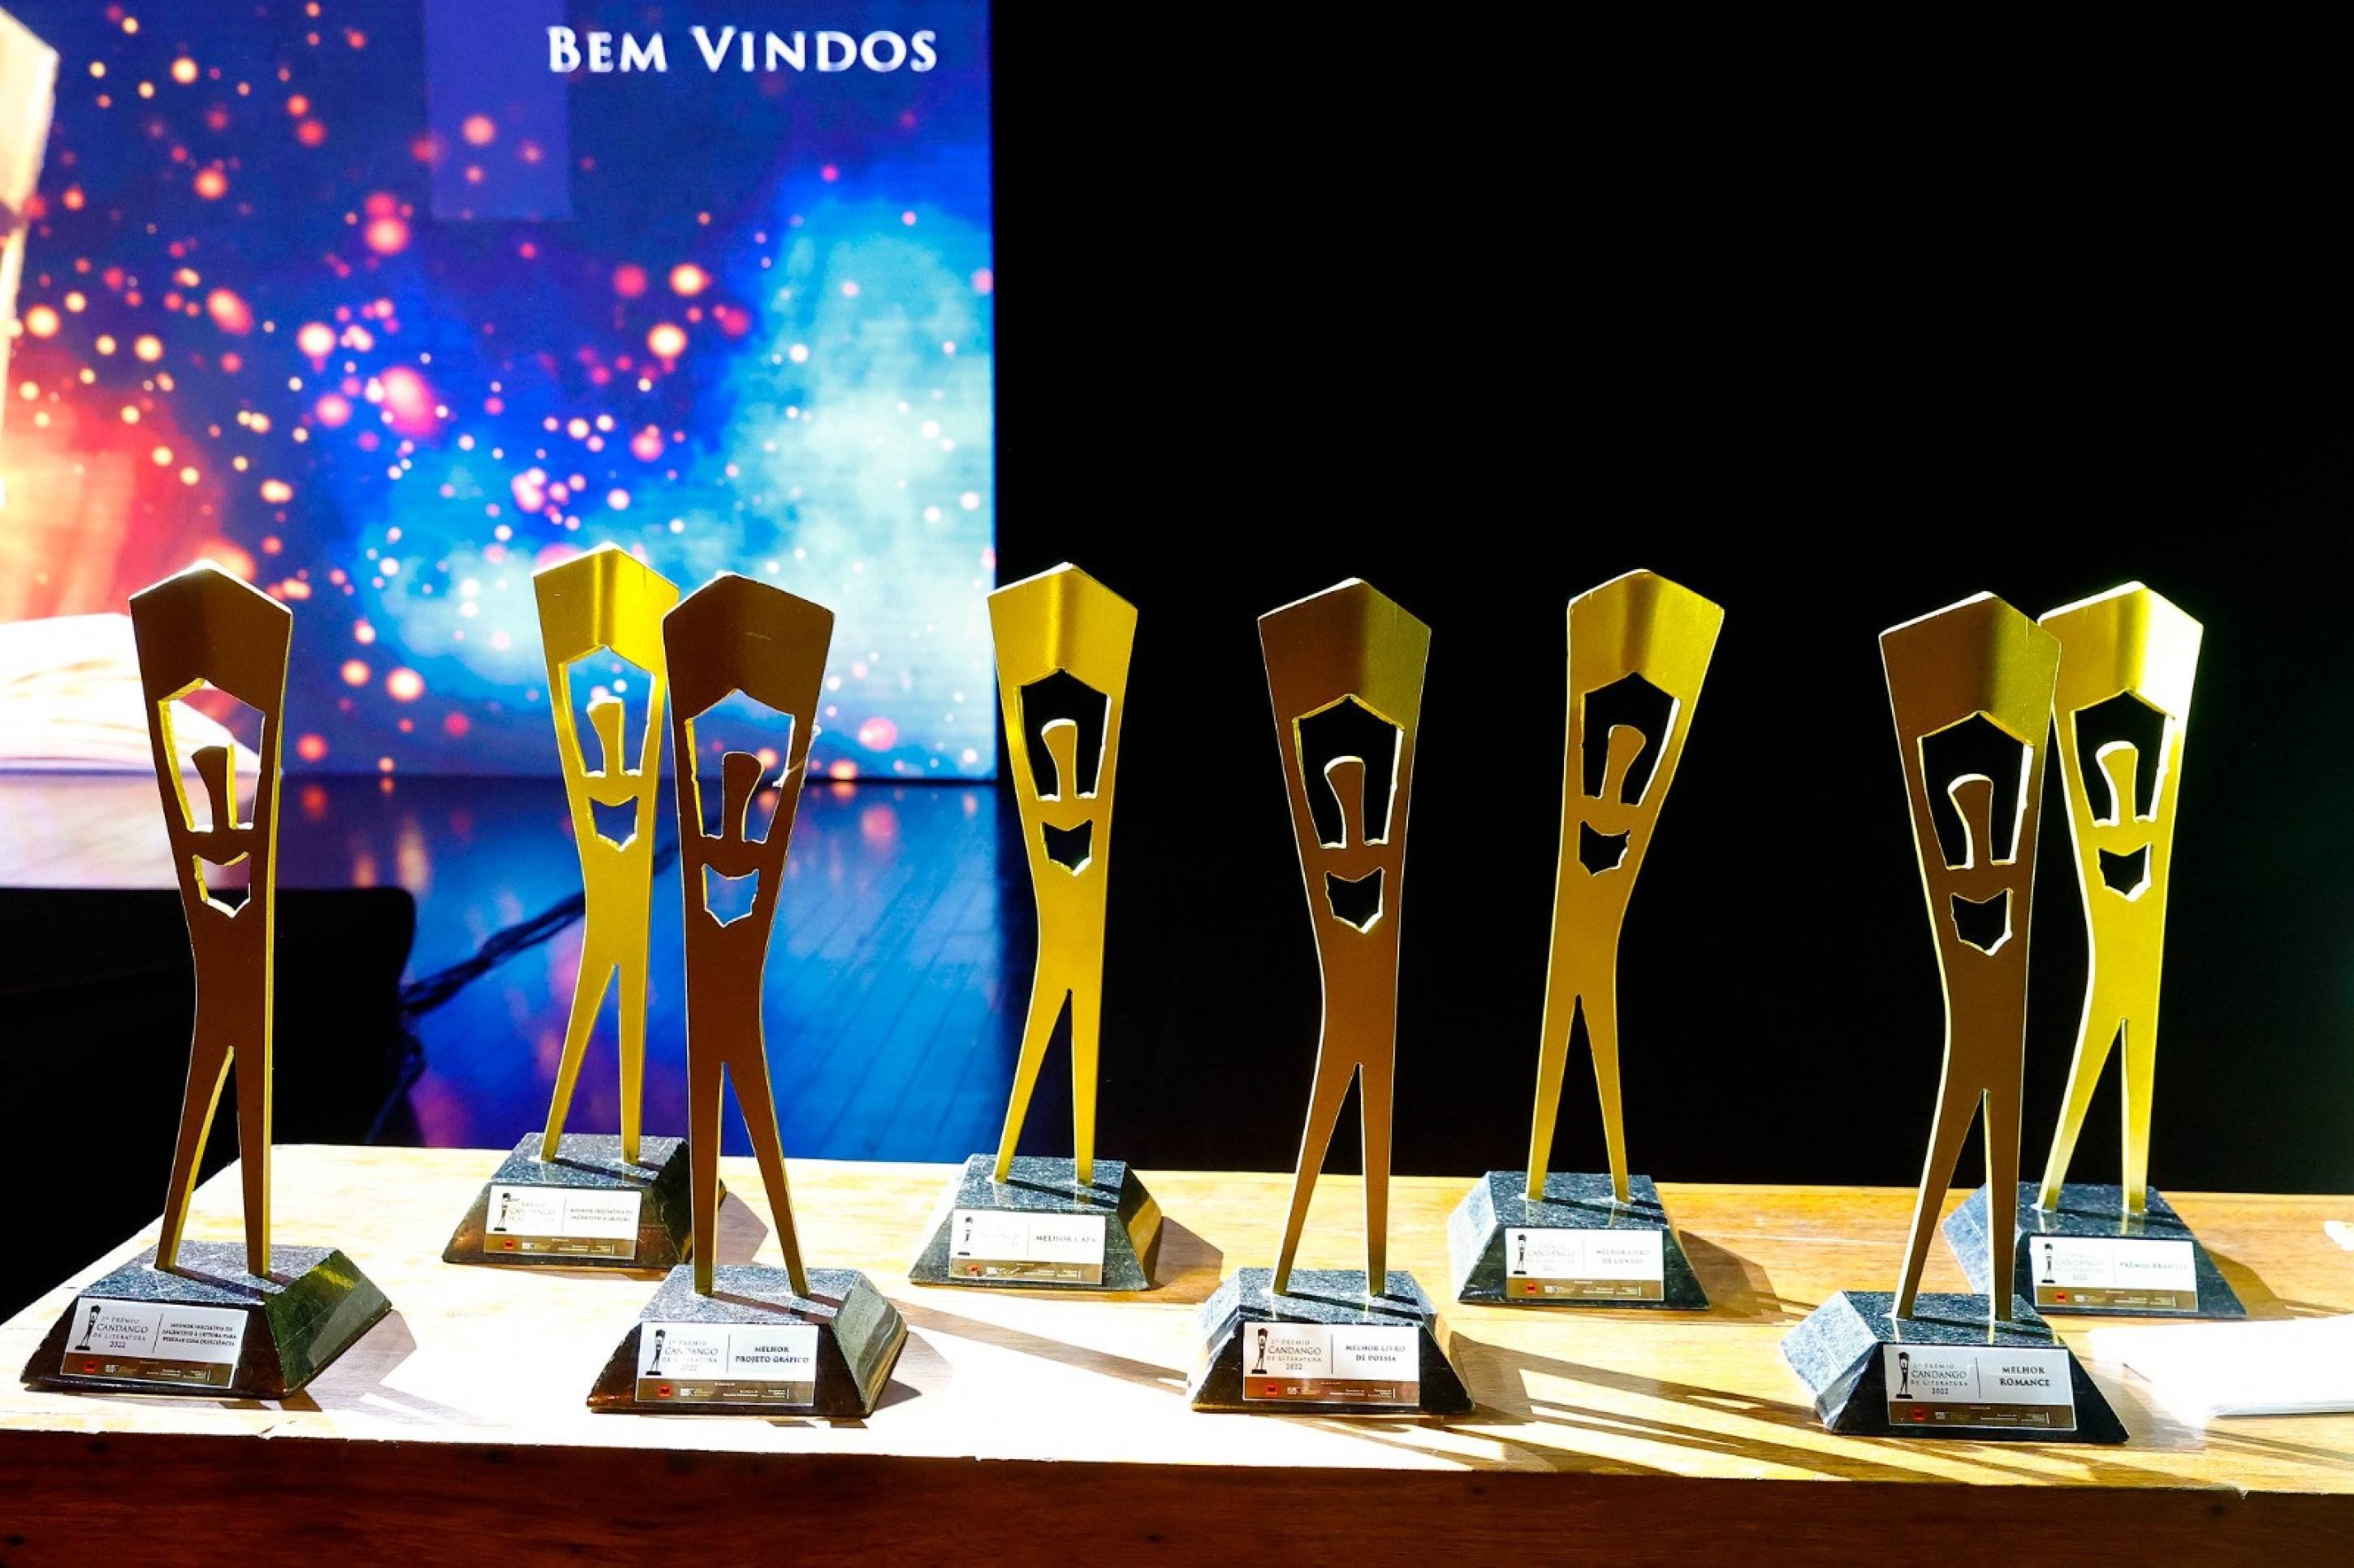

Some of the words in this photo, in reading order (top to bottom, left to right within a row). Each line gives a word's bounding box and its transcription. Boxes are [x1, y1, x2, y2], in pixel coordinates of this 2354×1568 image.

[96, 1324, 149, 1333] CANDANGO
[1268, 1346, 1322, 1355] CANDANGO
[773, 1355, 809, 1363] GRÁFICO
[1911, 1370, 1967, 1379] CANDANGO
[1999, 1378, 2050, 1386] ROMANCE
